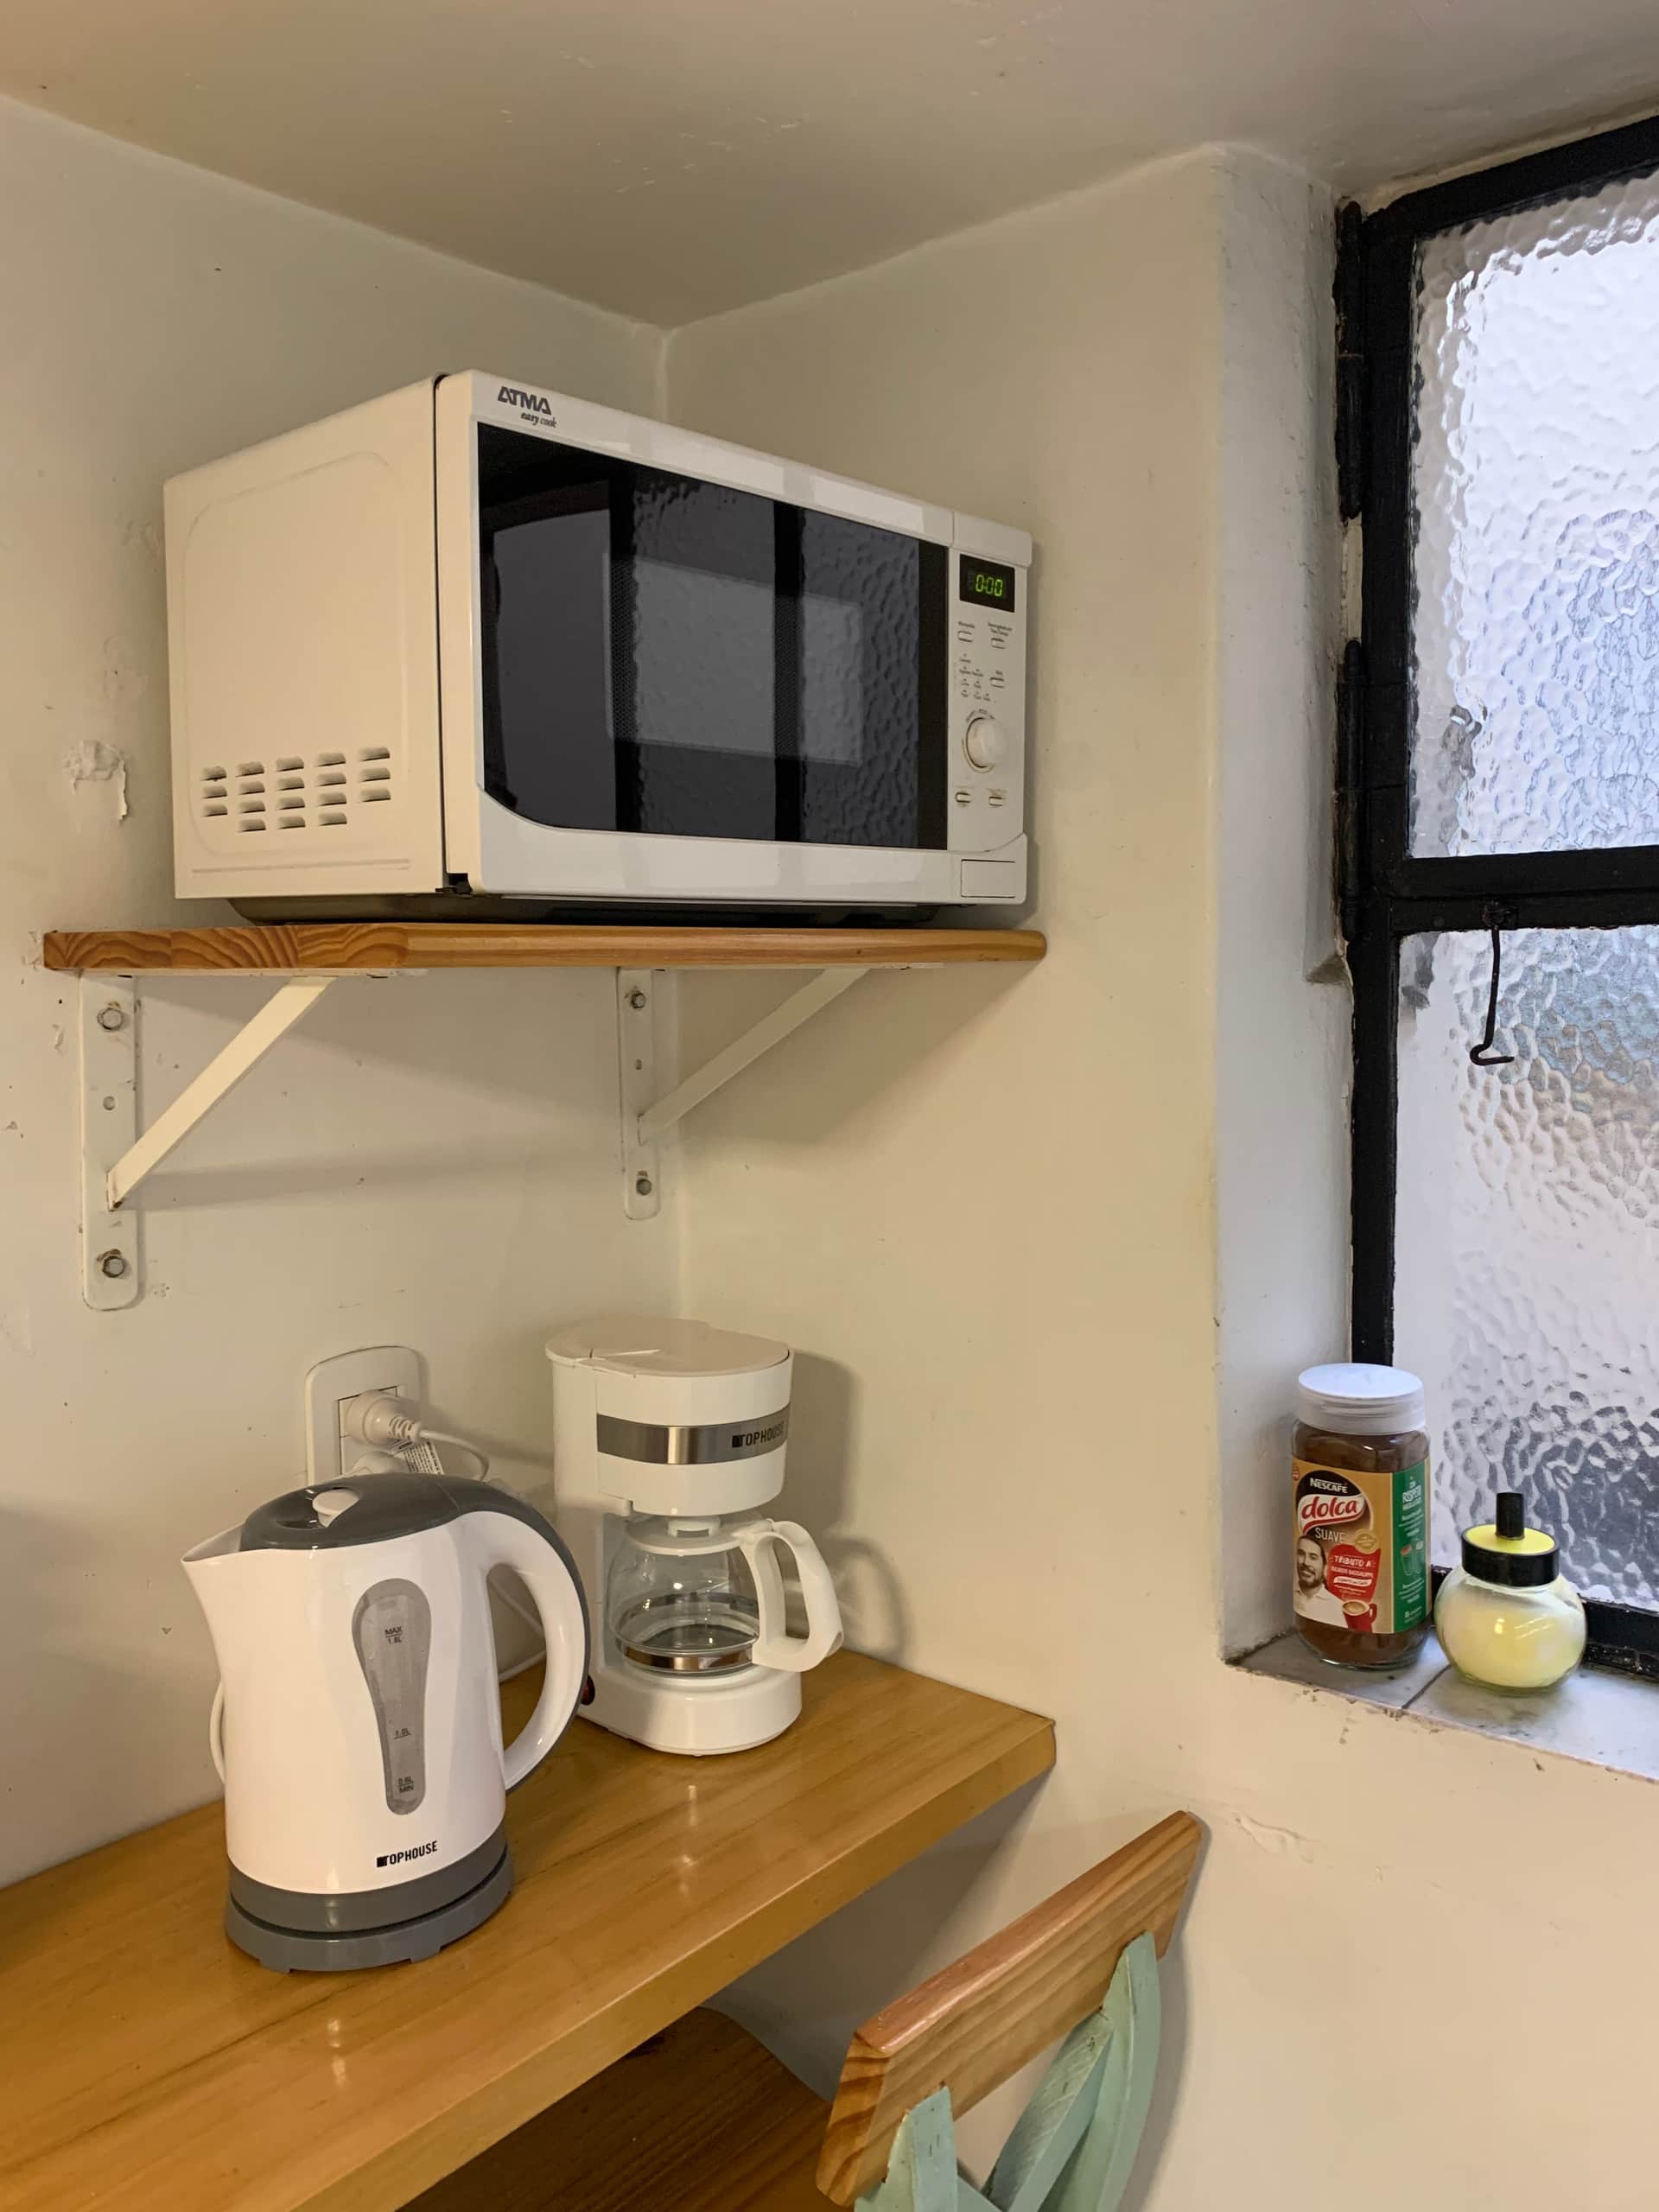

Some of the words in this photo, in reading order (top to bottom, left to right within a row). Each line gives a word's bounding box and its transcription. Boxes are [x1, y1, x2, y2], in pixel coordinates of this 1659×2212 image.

[498, 385, 552, 416] ATMA
[520, 412, 539, 426] easy
[540, 416, 557, 429] cook
[975, 574, 1003, 597] 0:00
[1301, 1496, 1357, 1519] dolca
[1314, 1528, 1345, 1542] SUAVE
[1335, 1554, 1364, 1567] TRIBUTO
[385, 1626, 402, 1636] MAX
[377, 1840, 438, 1868] TOPHOUSE
